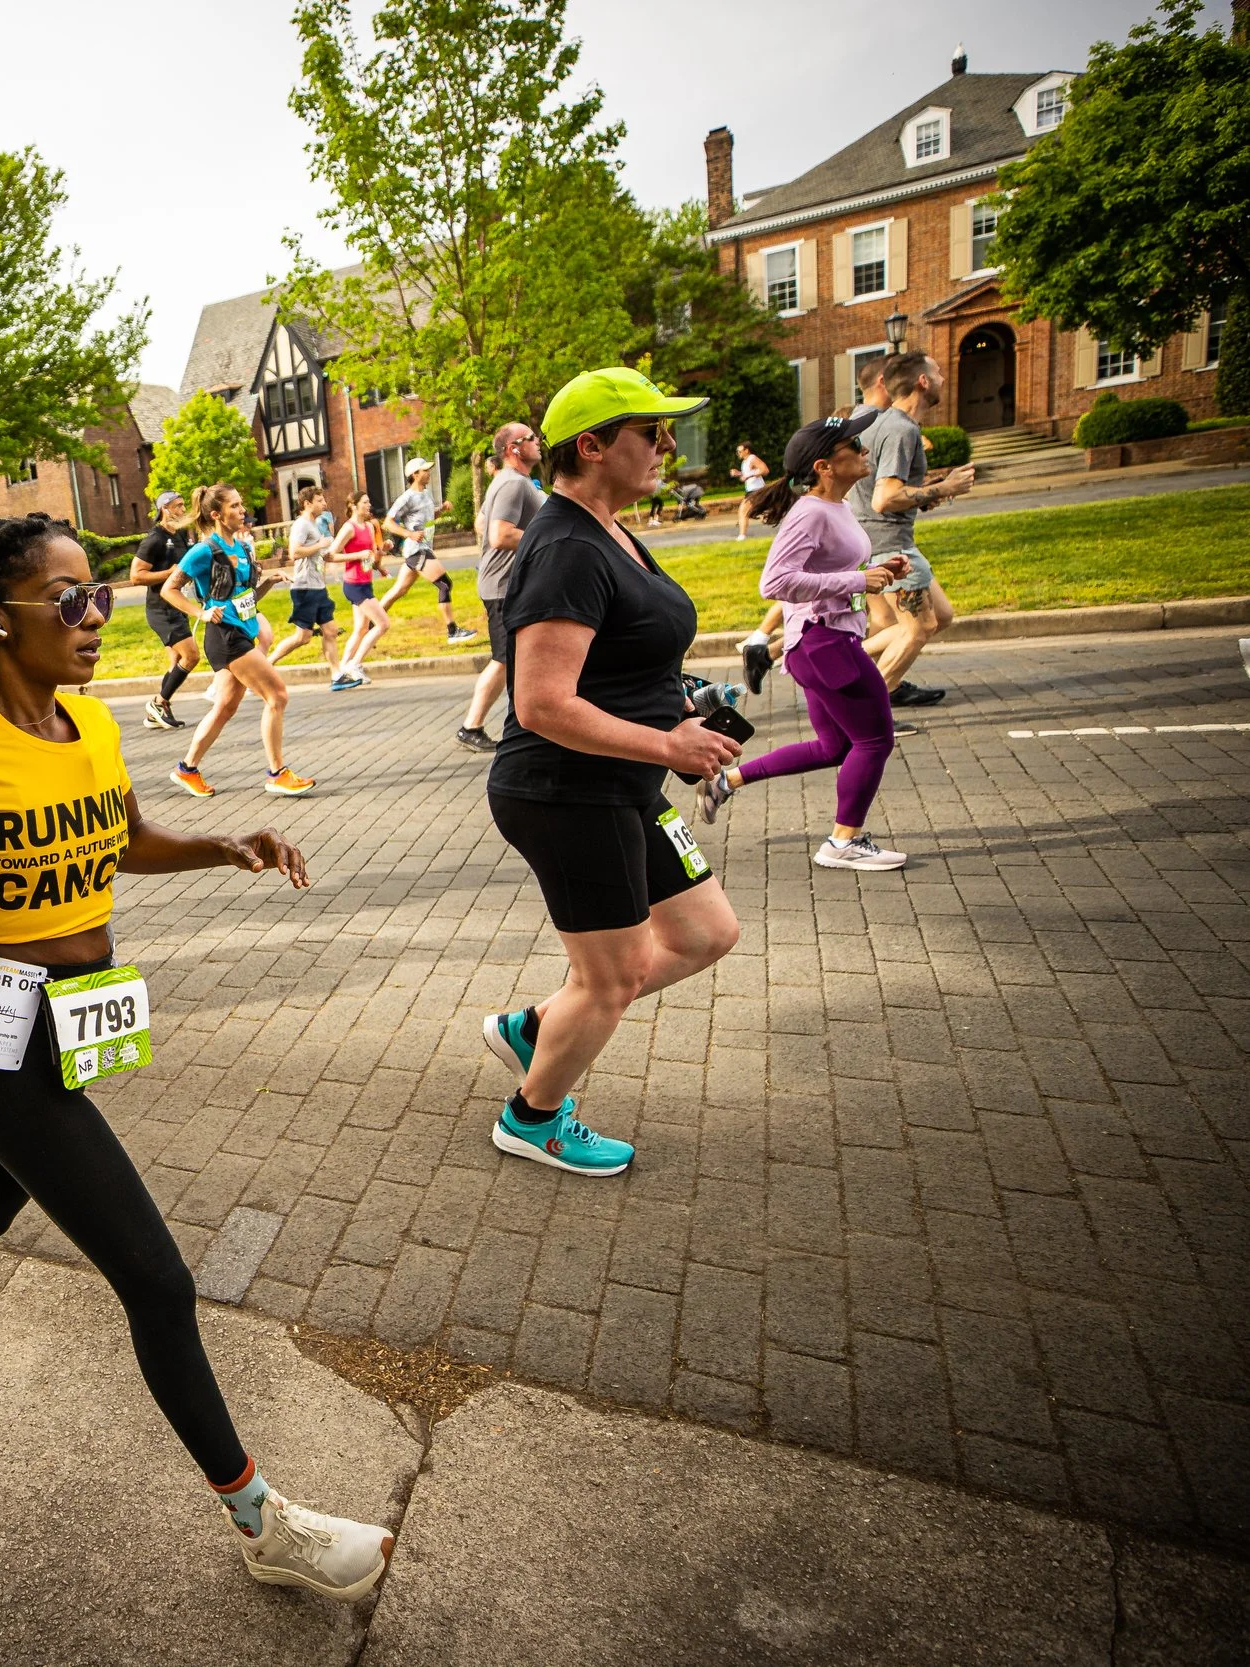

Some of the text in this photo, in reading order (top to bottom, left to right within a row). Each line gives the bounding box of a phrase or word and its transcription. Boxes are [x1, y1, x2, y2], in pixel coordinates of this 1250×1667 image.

[63, 849, 73, 861] A
[76, 835, 116, 858] FUTURE
[18, 979, 38, 992] OF
[70, 995, 136, 1041] 7793
[78, 1059, 93, 1074] NB
